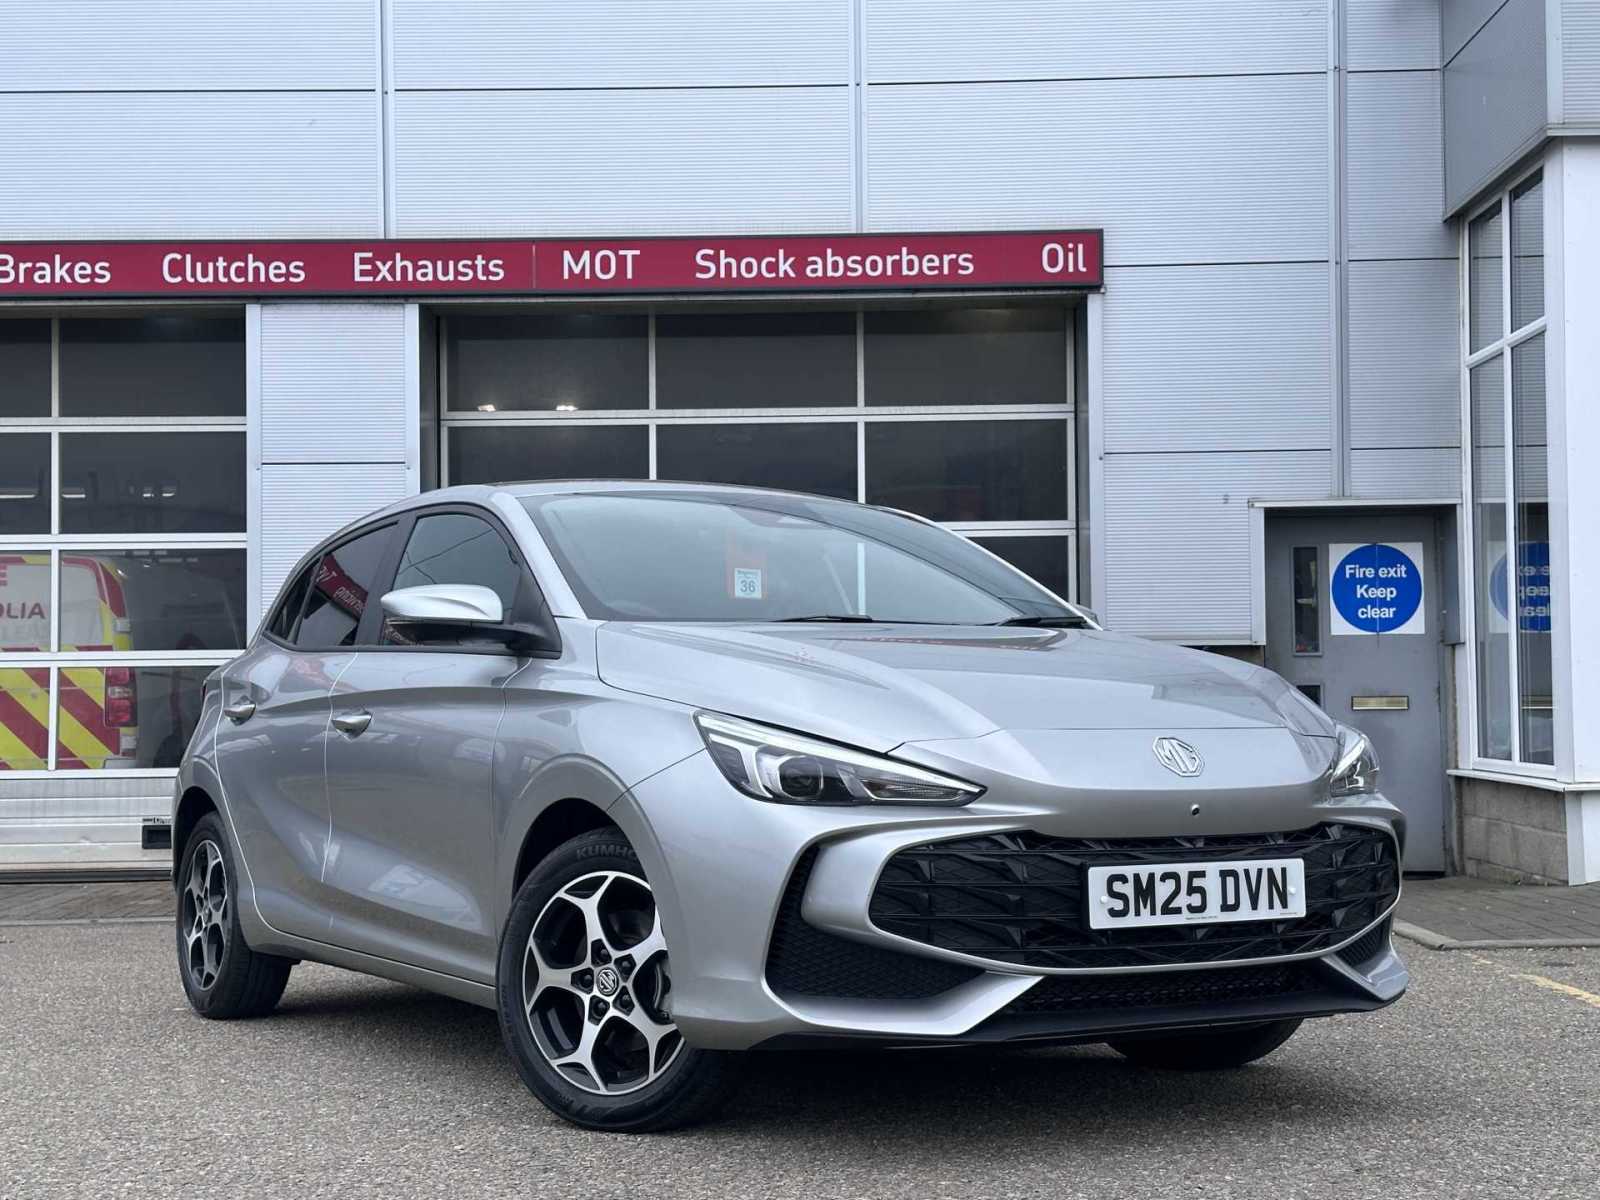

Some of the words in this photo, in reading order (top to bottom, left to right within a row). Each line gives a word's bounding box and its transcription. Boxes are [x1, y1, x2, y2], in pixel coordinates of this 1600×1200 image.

[0, 253, 112, 284] Brakes
[161, 252, 306, 284] Clutches
[353, 251, 505, 283] Exhausts
[562, 249, 641, 280] MOT
[694, 248, 796, 279] Shock
[805, 246, 975, 277] absorbers
[1041, 242, 1087, 273] Oil
[1345, 564, 1375, 579] Fire
[1378, 563, 1407, 578] exit
[740, 579, 756, 593] 36
[1356, 584, 1397, 601] Keep
[1357, 604, 1397, 619] clear
[1154, 738, 1200, 776] MG
[1106, 871, 1208, 918] SM25
[1219, 867, 1289, 912] DVN
